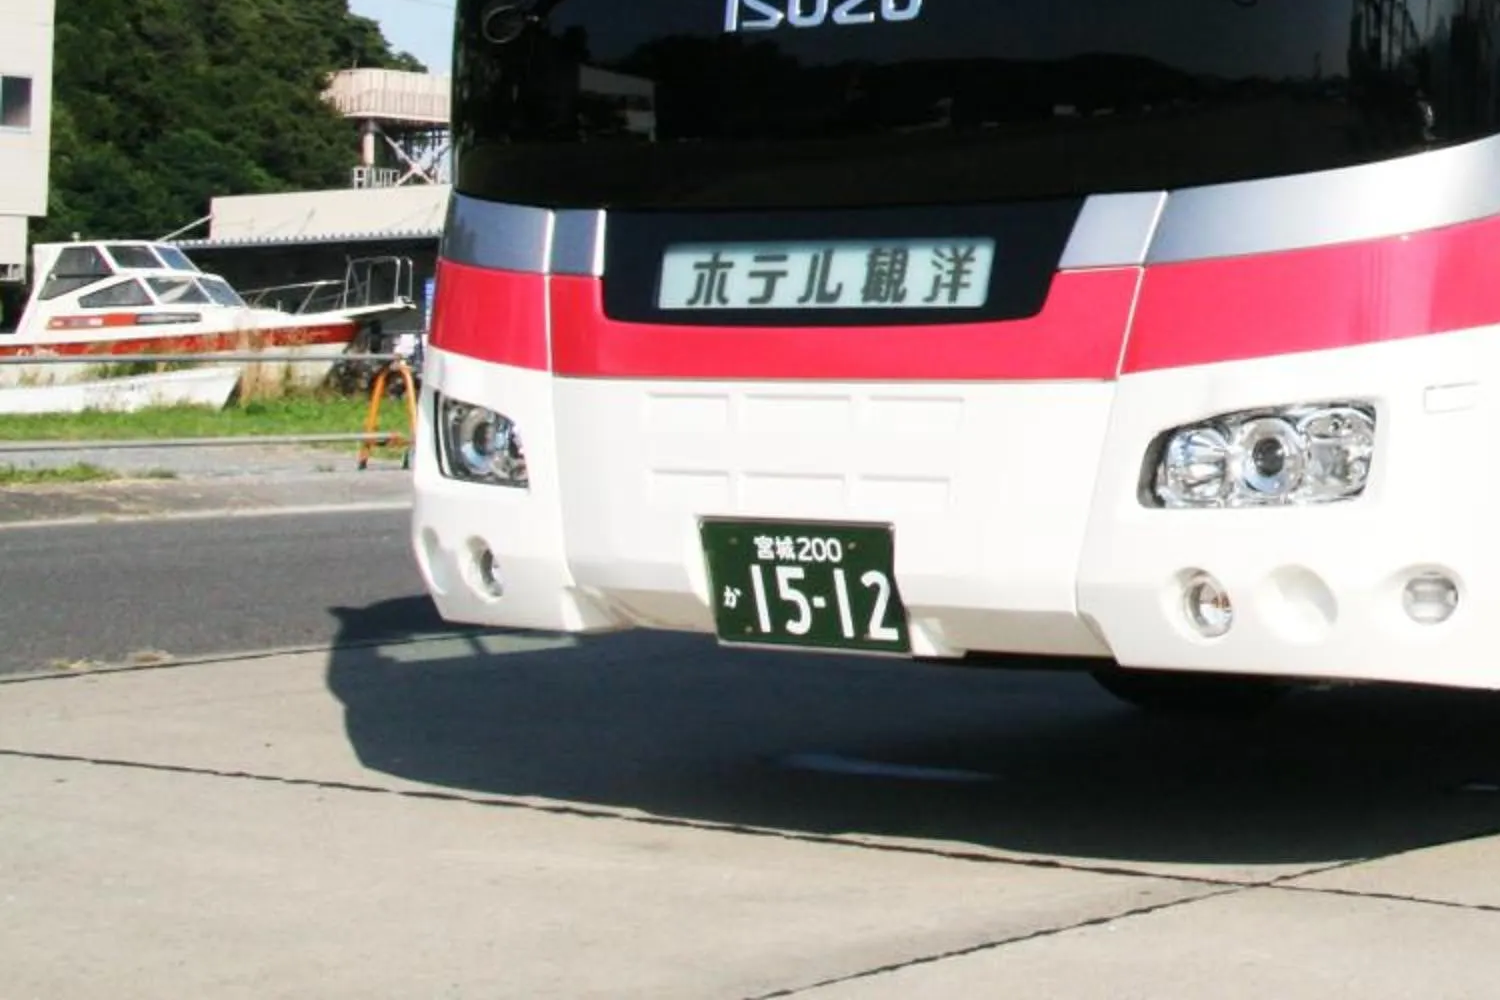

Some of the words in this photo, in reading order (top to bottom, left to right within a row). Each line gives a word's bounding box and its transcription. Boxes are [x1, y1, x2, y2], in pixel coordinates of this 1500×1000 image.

[687, 248, 976, 306] ホテル観洋
[723, 585, 743, 609] か
[751, 564, 899, 641] 15-12
